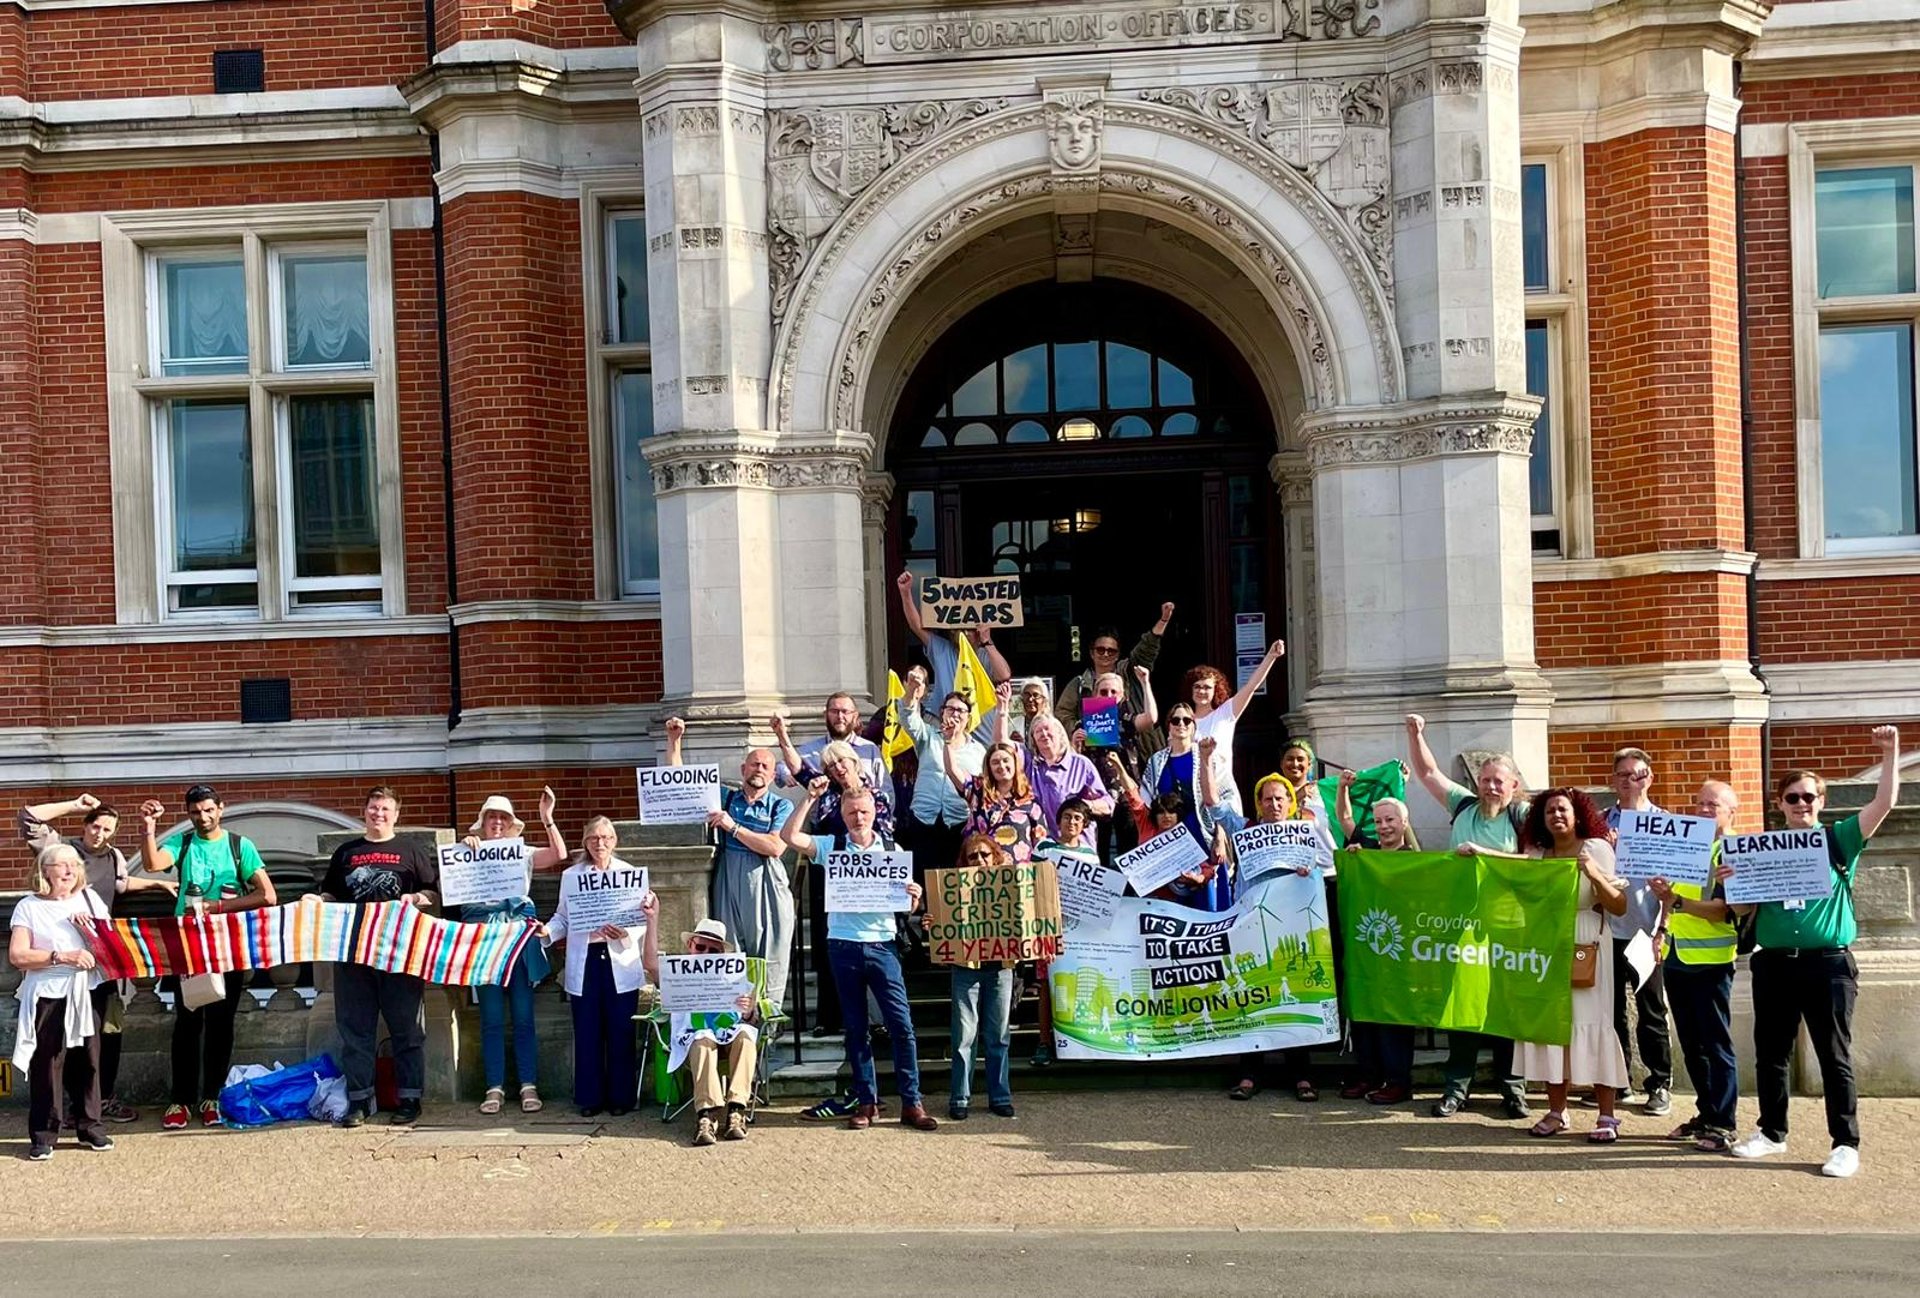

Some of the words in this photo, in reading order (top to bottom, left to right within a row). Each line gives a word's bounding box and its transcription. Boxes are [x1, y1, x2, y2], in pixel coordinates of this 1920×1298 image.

[890, 13, 1102, 52] CORPORATION
[1120, 4, 1254, 38] OFFICES
[922, 578, 941, 604] 5
[942, 580, 1021, 601] WASTED
[934, 602, 1014, 625] YEARS
[640, 768, 718, 786] FLOODING
[1234, 823, 1310, 847] PROVIDING
[1635, 815, 1697, 838] HEAT
[441, 844, 523, 865] ECOLOGICAL
[1118, 825, 1187, 868] CANCELLED
[1238, 834, 1316, 856] PROTECTING
[1723, 832, 1823, 855] LEARNING
[828, 854, 872, 866] JOBS
[1056, 855, 1107, 886] FIRE
[577, 869, 644, 892] HEALTH
[829, 866, 908, 879] FINANCES
[943, 865, 1037, 889] CROYDON
[943, 883, 1035, 906] CLIMATE
[951, 902, 1025, 923] CRISIS
[1415, 911, 1482, 933] Croydon
[930, 917, 1057, 941] COMMISSION
[1144, 916, 1177, 935] IT'S
[1194, 918, 1233, 935] TIME
[935, 940, 955, 962] 4
[1147, 942, 1165, 957] TO
[1175, 936, 1224, 956] TAKE
[667, 957, 745, 975] TRAPPED
[1154, 963, 1218, 986] ACTION
[1115, 997, 1175, 1017] COME
[1178, 993, 1229, 1016] JOIN
[1234, 985, 1272, 1008] US!
